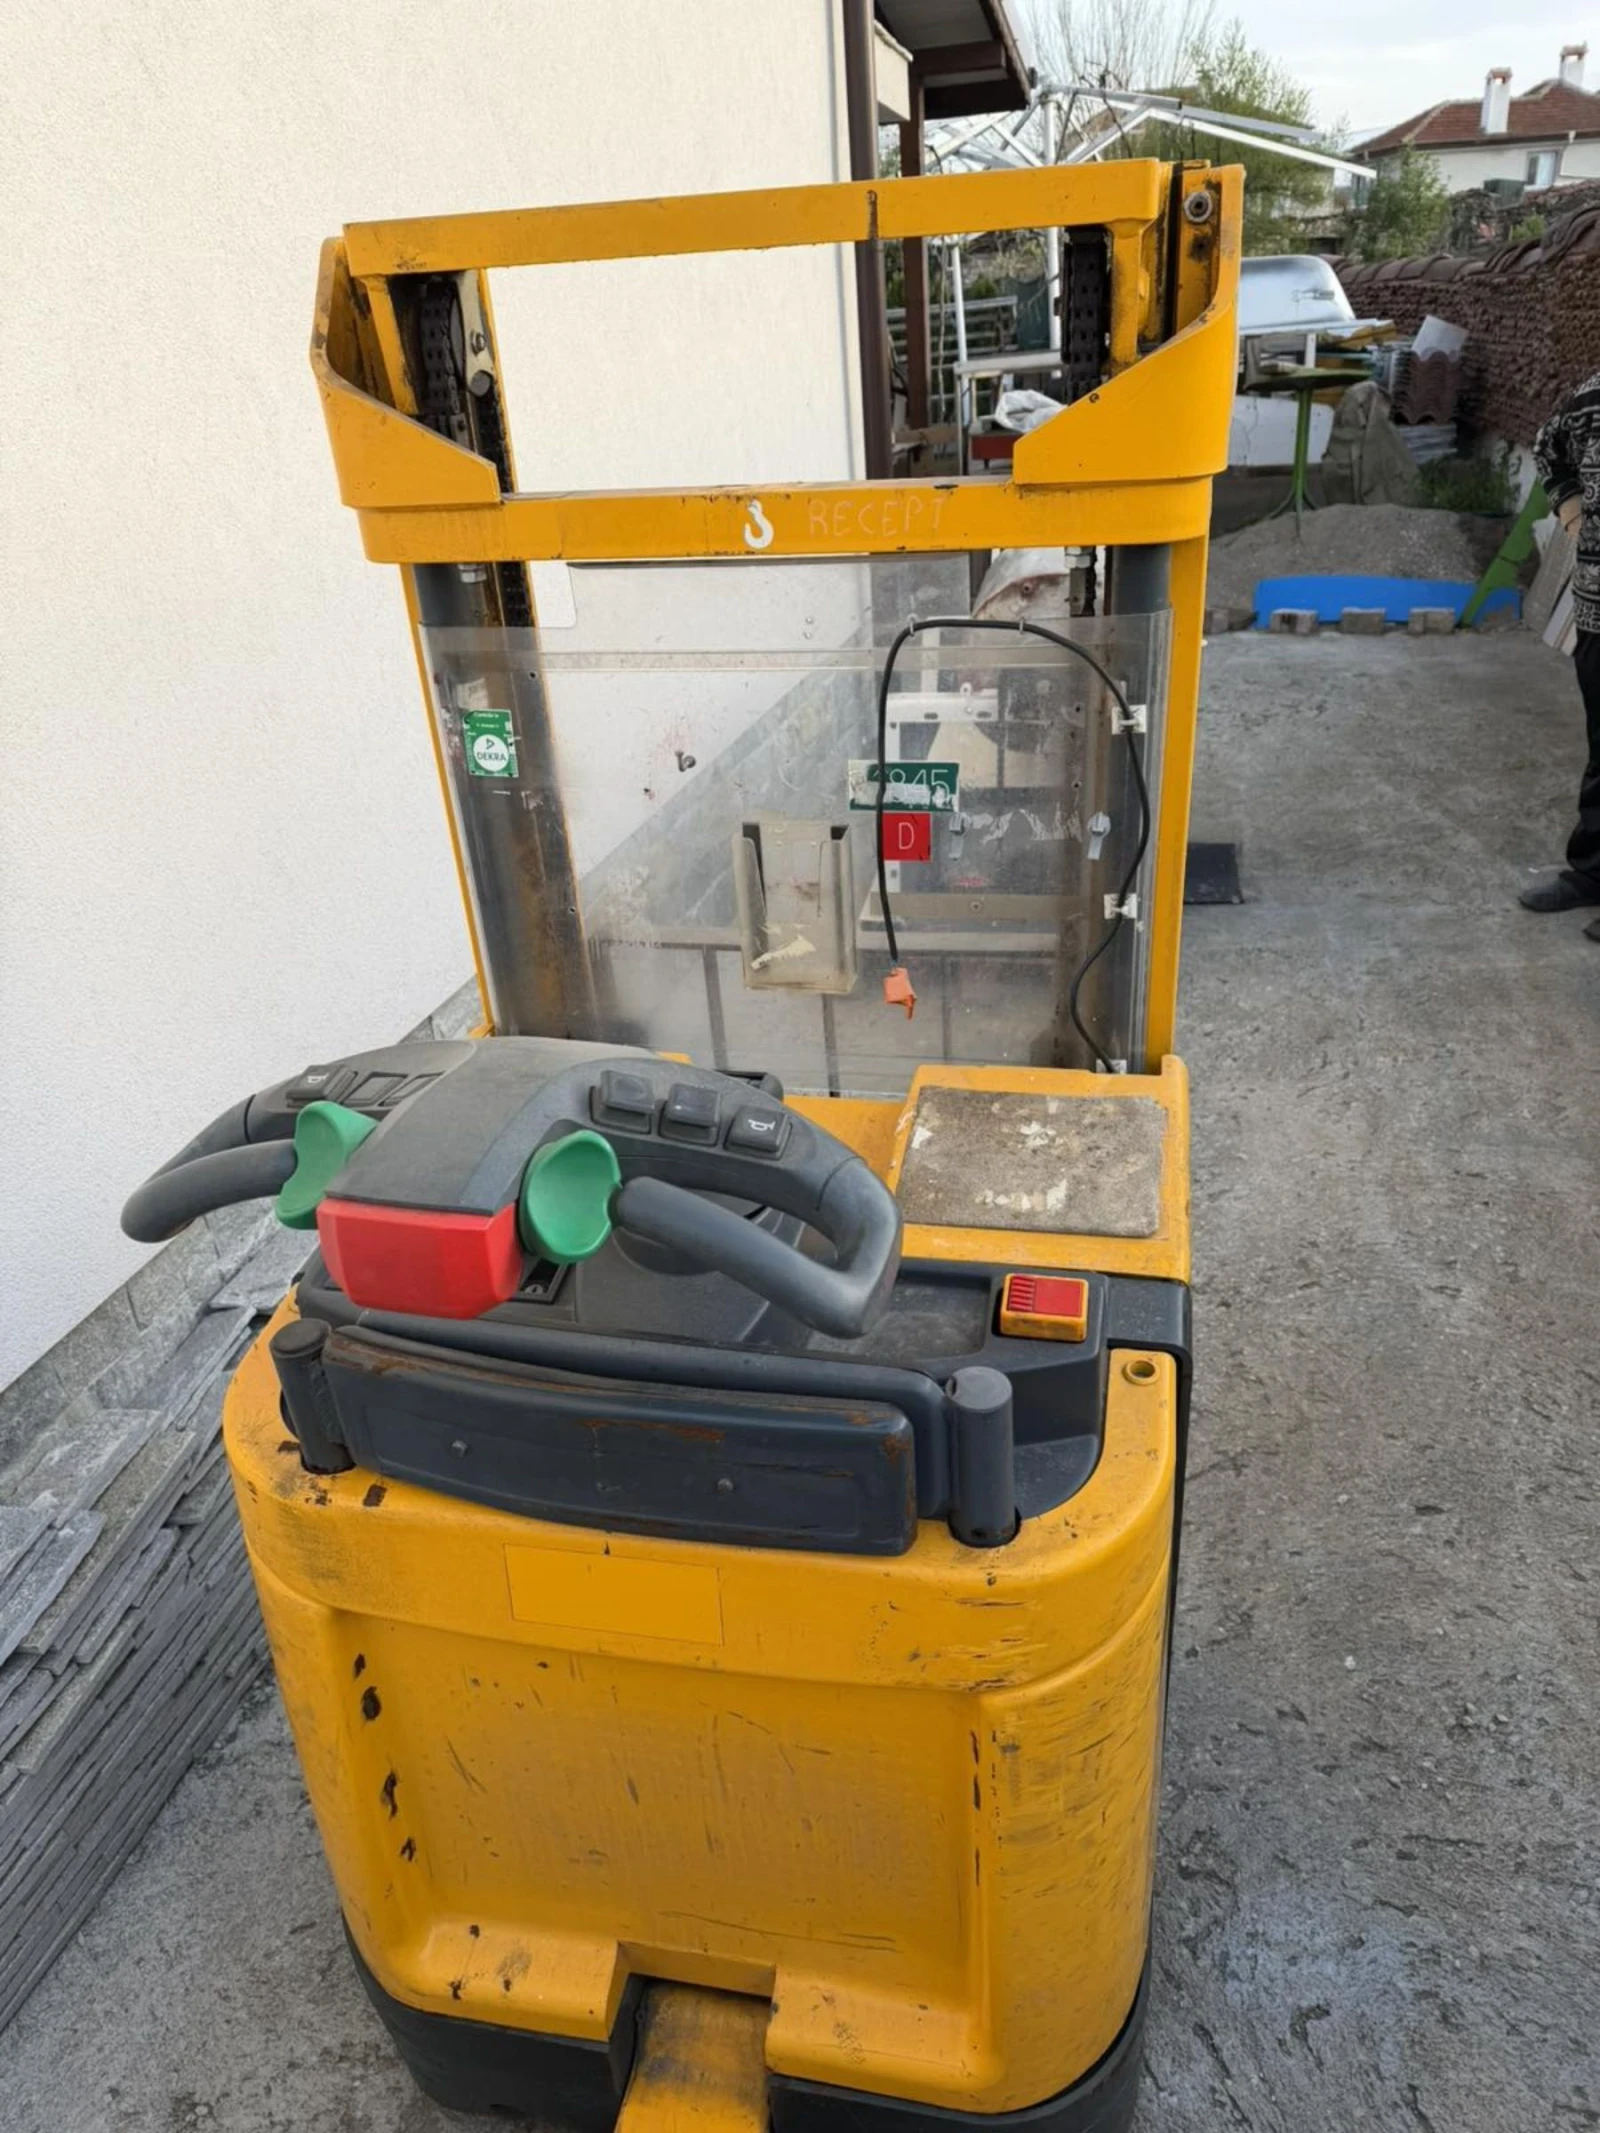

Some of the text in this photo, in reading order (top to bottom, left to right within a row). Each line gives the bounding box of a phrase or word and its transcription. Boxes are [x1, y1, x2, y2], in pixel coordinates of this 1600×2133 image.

[808, 495, 948, 537] RECEPT
[476, 751, 508, 761] DEKRA
[898, 821, 916, 850] D
